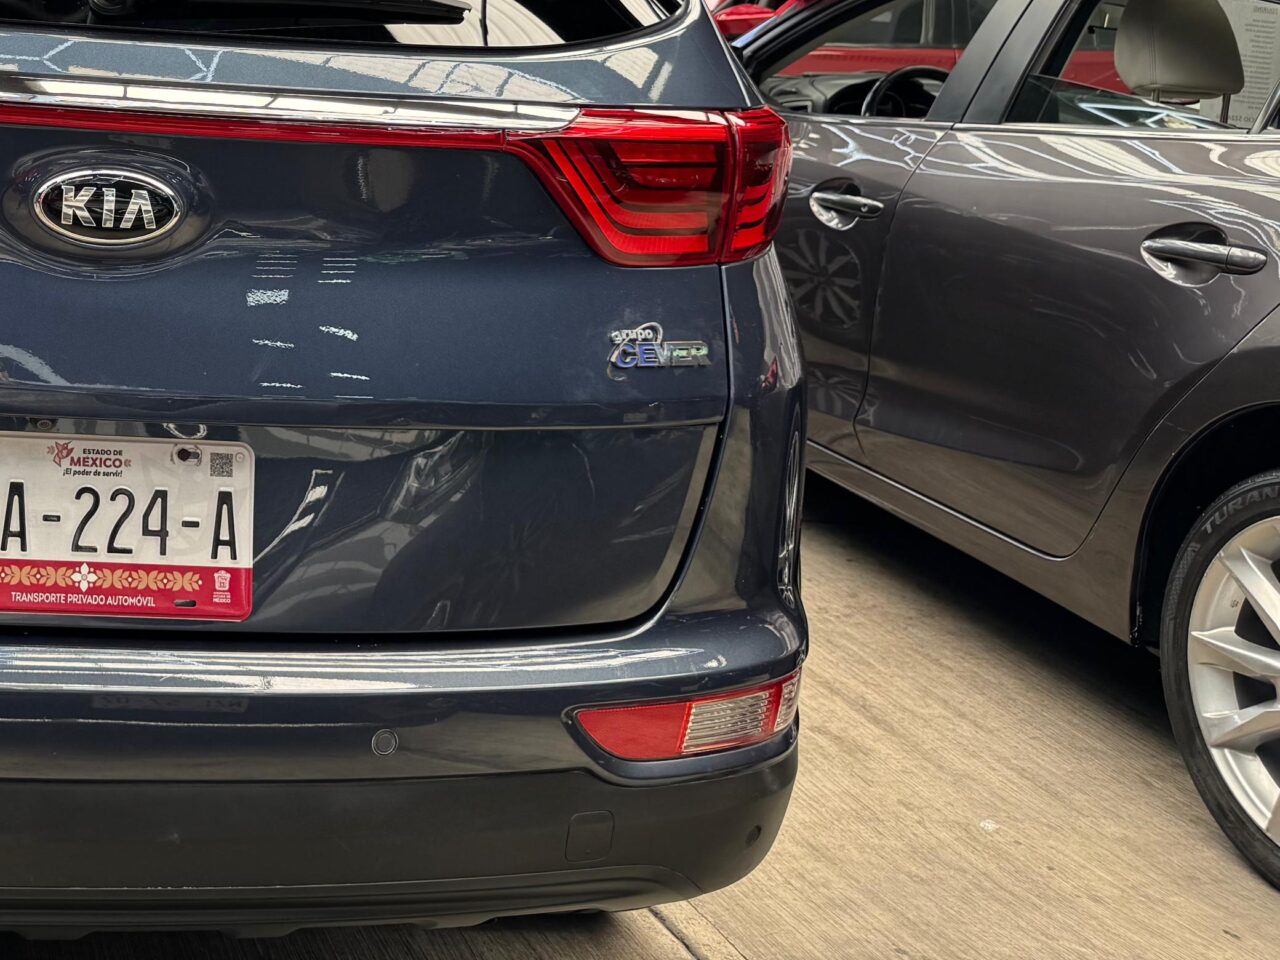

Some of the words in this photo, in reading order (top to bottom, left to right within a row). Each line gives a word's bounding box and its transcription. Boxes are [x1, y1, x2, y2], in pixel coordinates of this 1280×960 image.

[61, 185, 157, 229] KIA
[82, 448, 112, 456] ESTADO
[69, 456, 123, 469] MÉXICO
[72, 469, 92, 477] poder
[11, 591, 66, 604] TRANSPORTE
[67, 593, 106, 605] PRIVADO
[106, 594, 156, 607] AUTOMÓVIL
